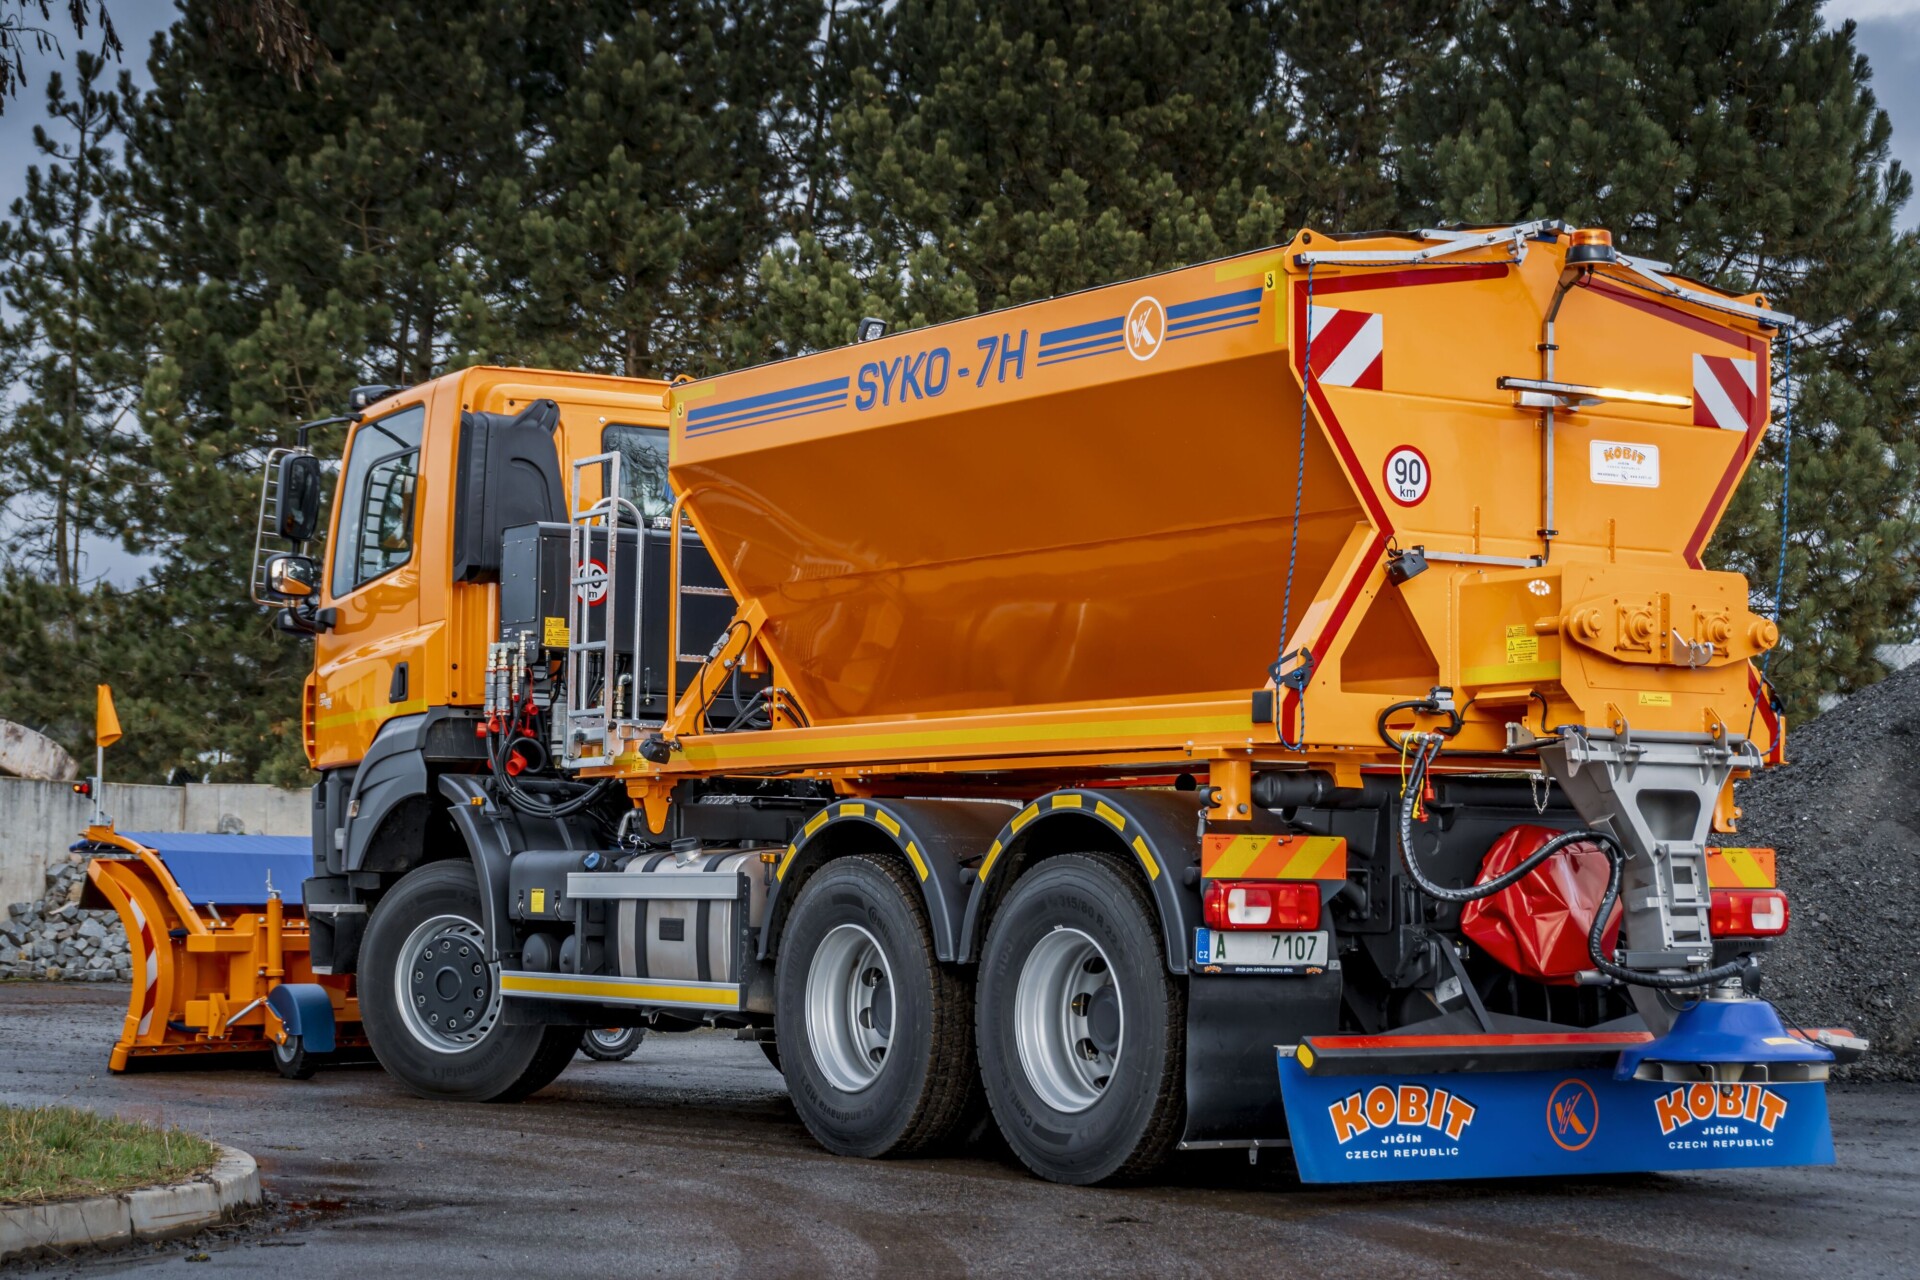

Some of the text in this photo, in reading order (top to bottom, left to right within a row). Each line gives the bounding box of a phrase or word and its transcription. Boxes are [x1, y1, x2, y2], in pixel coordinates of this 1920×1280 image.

[855, 347, 951, 412] SYKO
[976, 329, 1029, 389] 7H
[1603, 447, 1646, 465] KOBIT
[1395, 458, 1421, 486] 90
[1400, 485, 1416, 498] km
[1198, 933, 1318, 961] CZ A 7107
[1328, 1084, 1477, 1145] KOBIT
[1654, 1083, 1788, 1136] KOBIT
[1381, 1133, 1422, 1144] JIČÍN
[1702, 1125, 1739, 1135] JIČÍN
[1668, 1138, 1775, 1150] CZECH REPUBLIC
[1345, 1147, 1459, 1160] CZECH REPUBLIC
